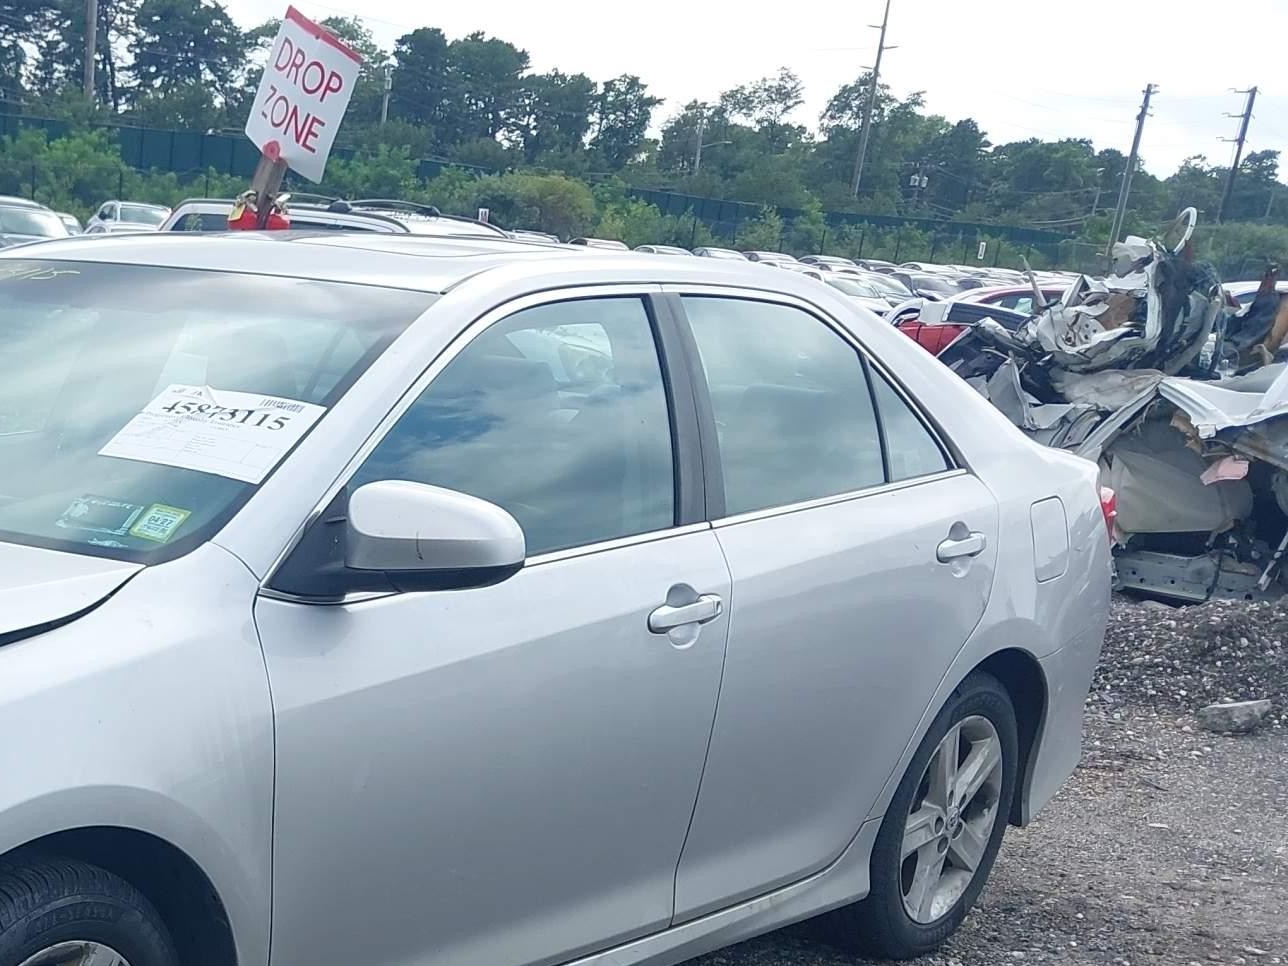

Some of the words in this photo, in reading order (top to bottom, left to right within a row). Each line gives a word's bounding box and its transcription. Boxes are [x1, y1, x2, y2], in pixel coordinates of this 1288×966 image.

[274, 36, 343, 102] DROP
[262, 84, 325, 153] ZONE
[161, 400, 291, 431] 45873115
